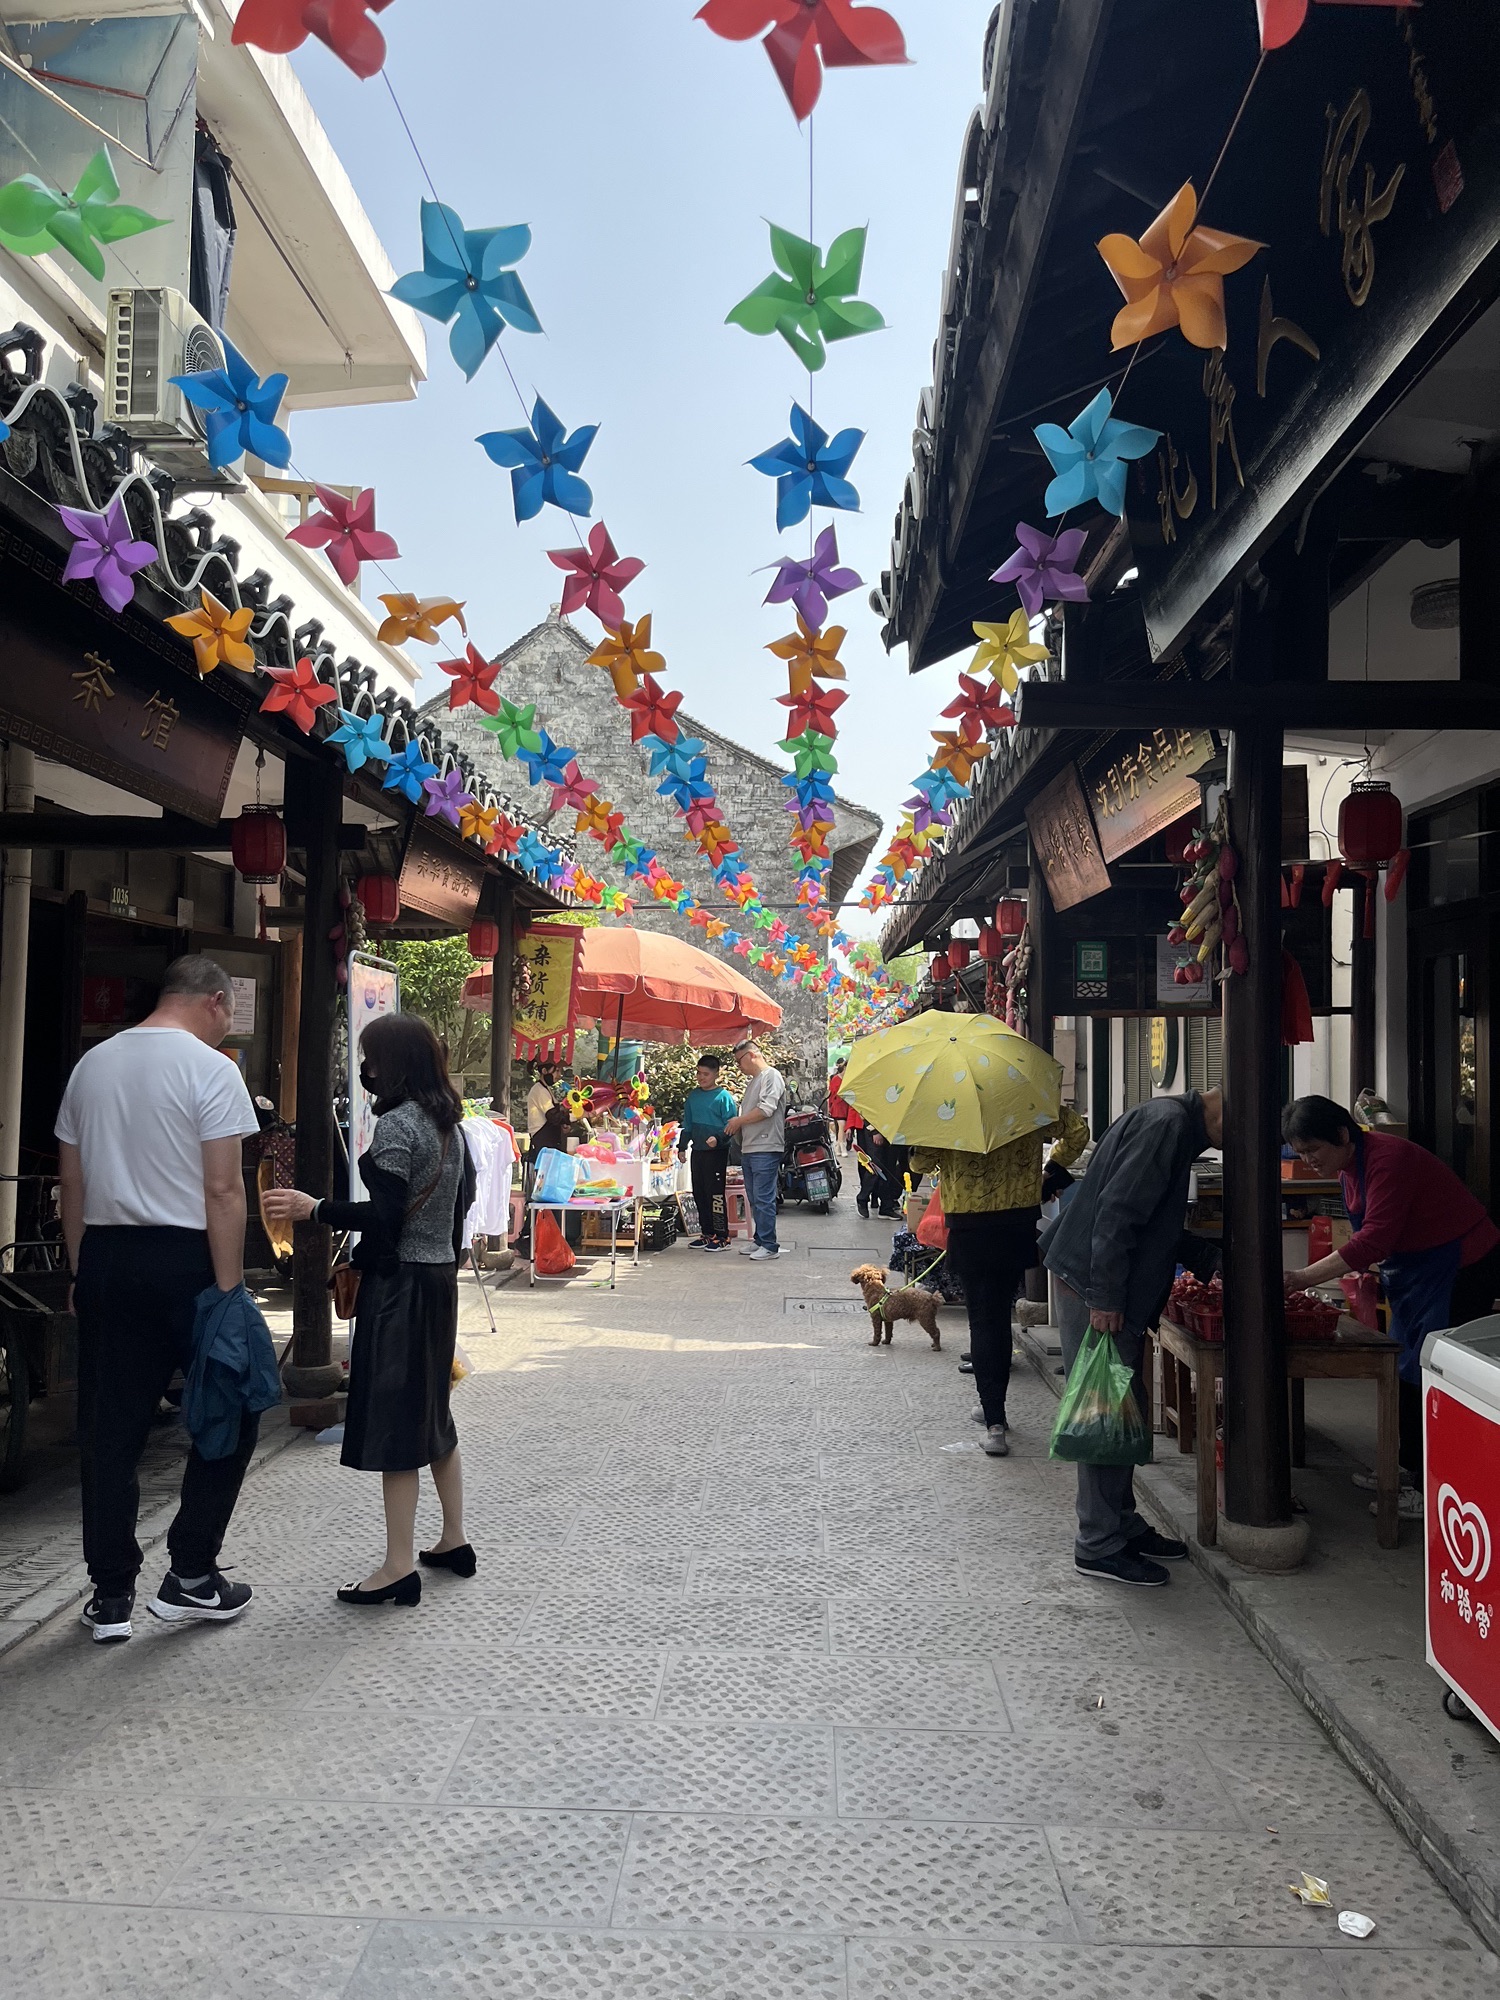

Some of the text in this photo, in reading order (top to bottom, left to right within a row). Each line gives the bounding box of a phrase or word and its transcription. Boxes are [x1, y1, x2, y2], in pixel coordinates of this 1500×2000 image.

[71, 650, 180, 750] 茶馆
[111, 886, 129, 905] 1036
[523, 944, 552, 1022] 杂货铺
[712, 1193, 725, 1214] ERA
[1439, 1569, 1491, 1639] 和路雪
